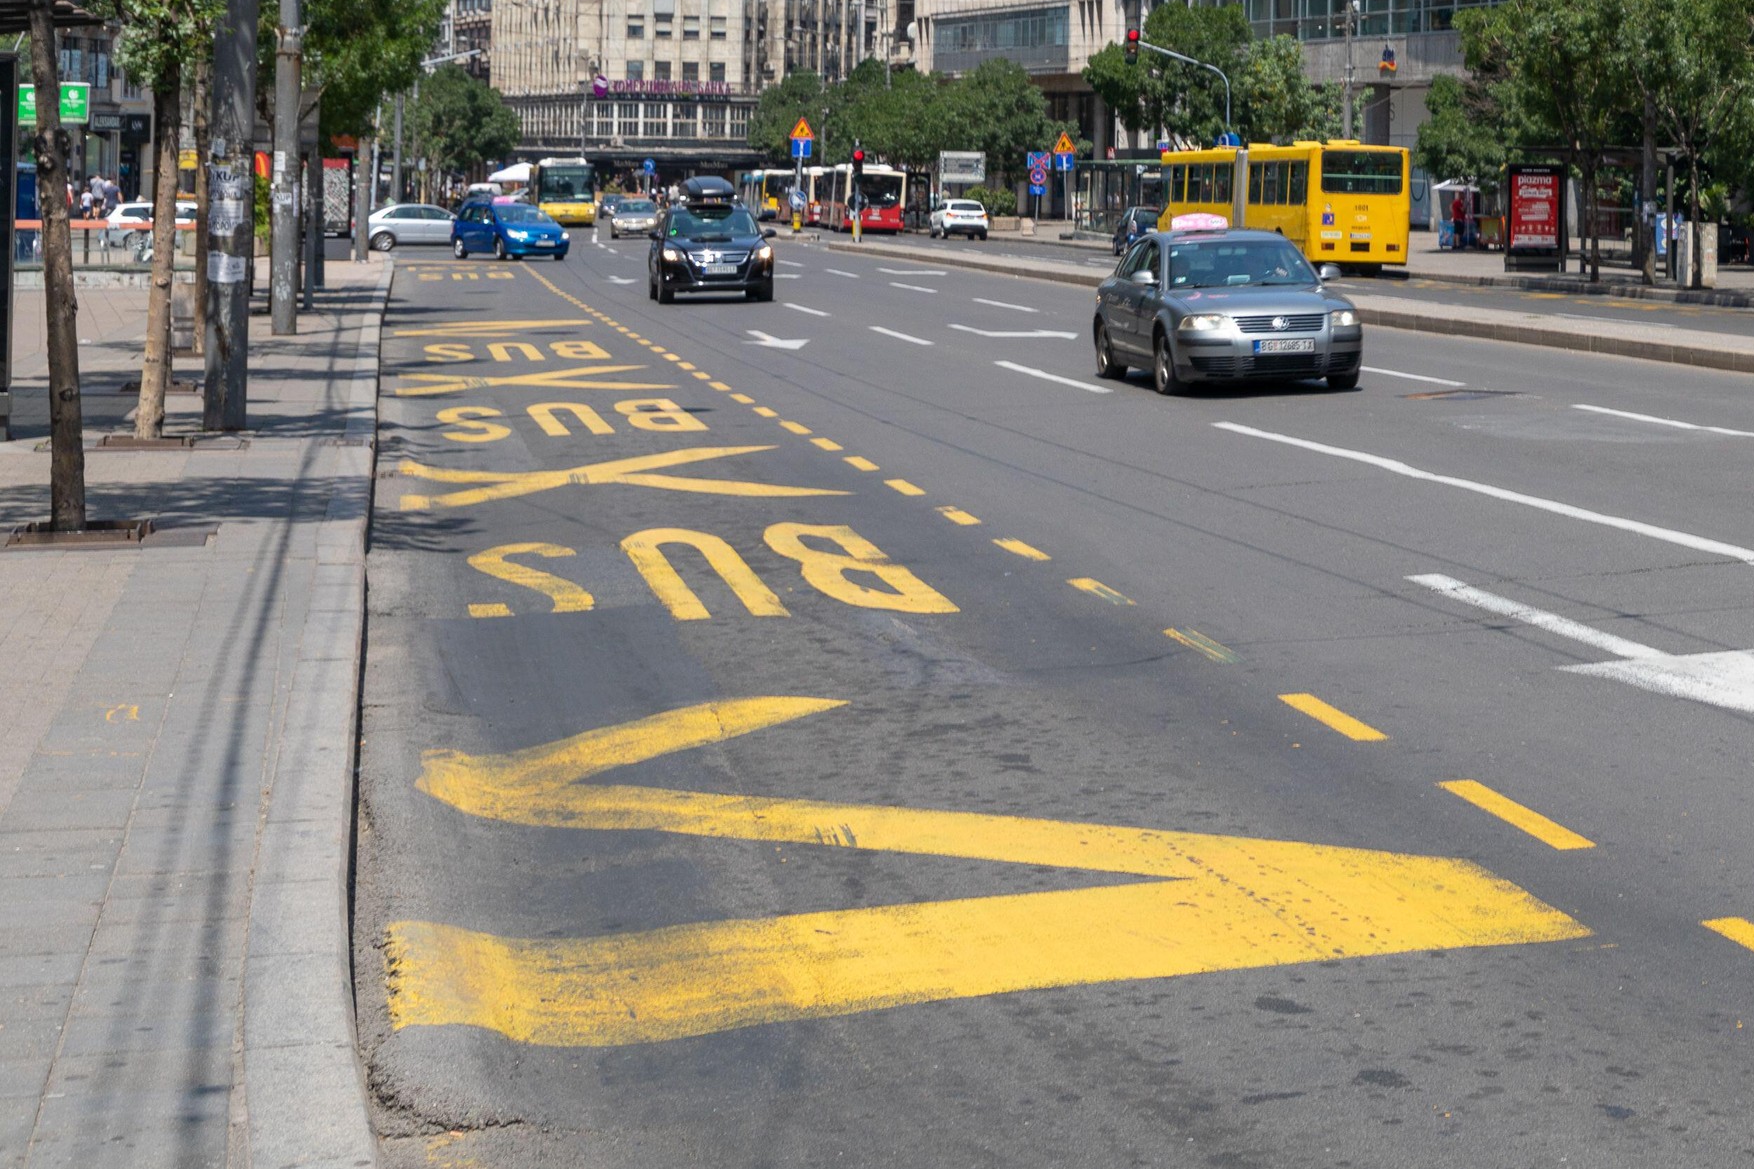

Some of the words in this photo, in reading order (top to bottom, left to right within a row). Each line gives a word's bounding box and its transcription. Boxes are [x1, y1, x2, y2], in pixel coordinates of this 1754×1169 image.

[1518, 176, 1552, 186] plazma
[423, 341, 613, 362] BUS
[1261, 340, 1274, 351] BG
[436, 399, 710, 442] BUS
[467, 522, 961, 621] BUS
